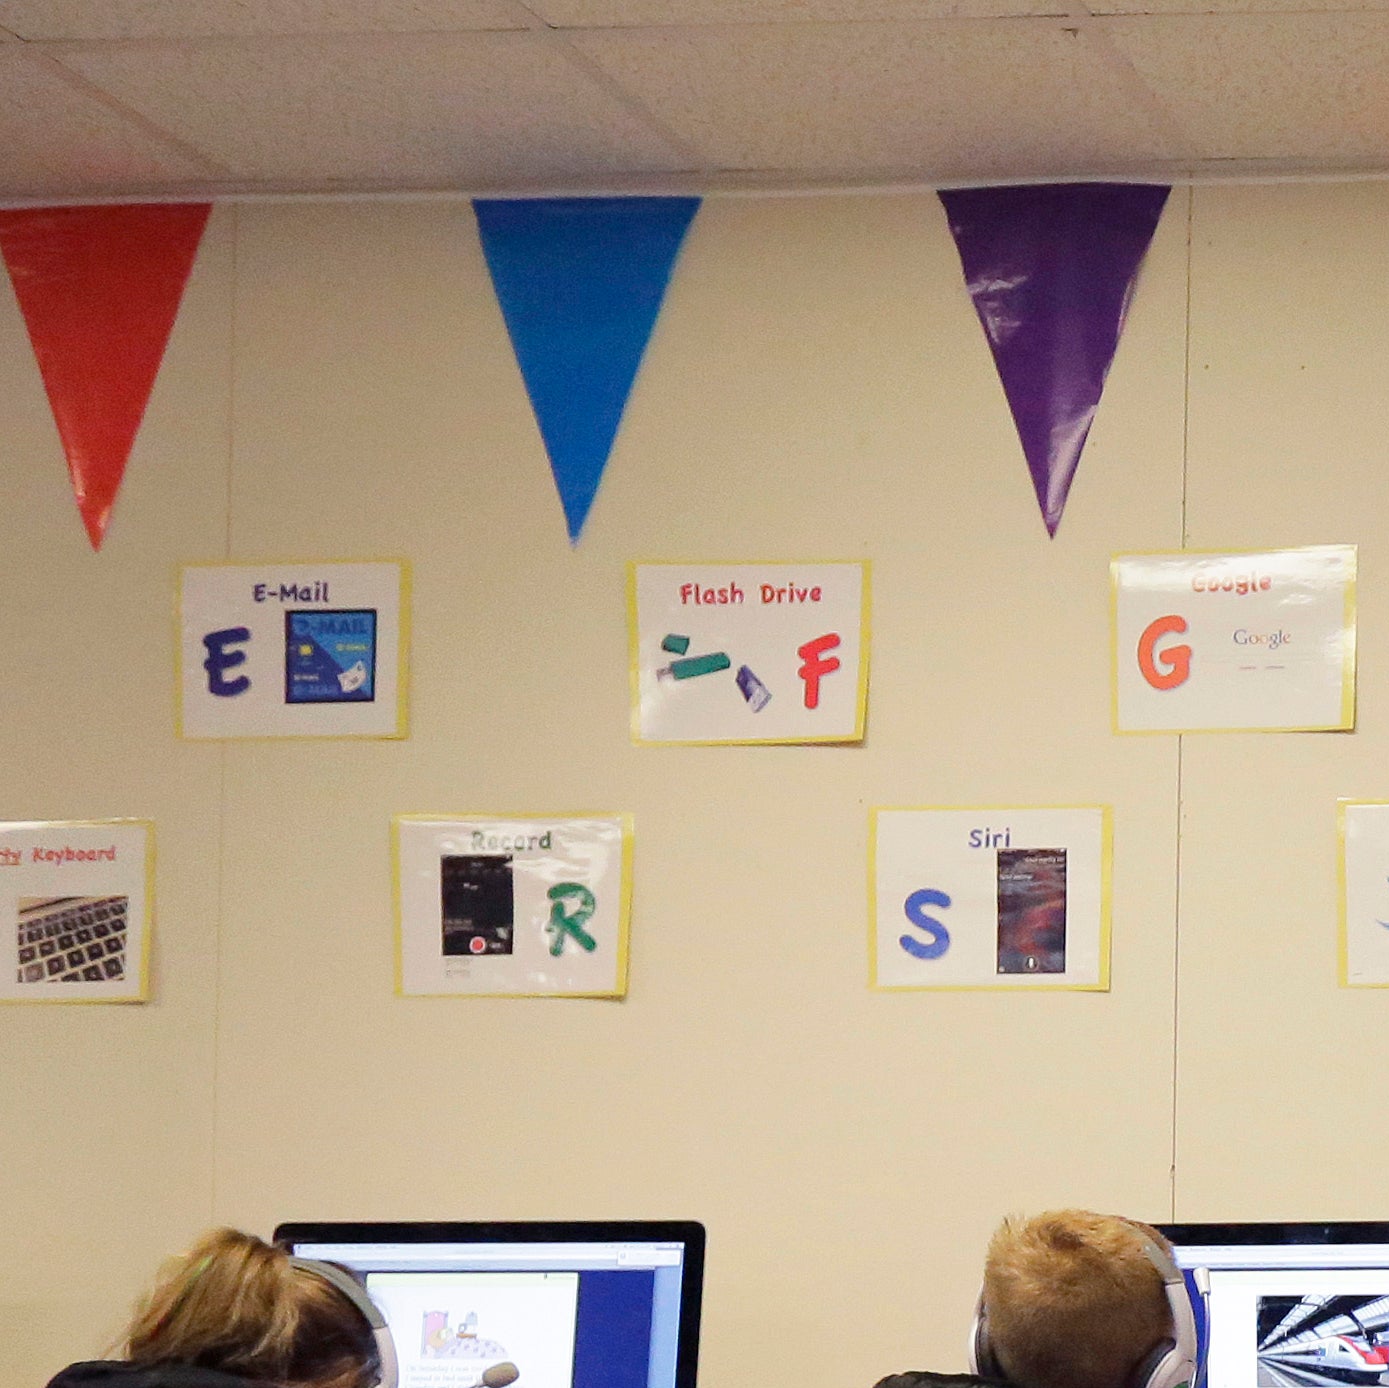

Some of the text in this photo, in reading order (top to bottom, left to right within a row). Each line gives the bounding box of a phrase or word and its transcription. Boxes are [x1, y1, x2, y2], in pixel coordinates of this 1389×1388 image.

[253, 581, 329, 603] E-Mail
[680, 581, 823, 604] Flash Drive
[1191, 571, 1272, 595] Google
[1233, 629, 1292, 650] Google
[203, 627, 251, 697] E
[1137, 615, 1192, 691] G
[797, 632, 841, 710] F
[471, 830, 552, 850] Record
[968, 828, 1011, 848] Siri
[32, 844, 116, 866] Keyboard
[547, 882, 597, 957] R
[900, 889, 951, 960] S
